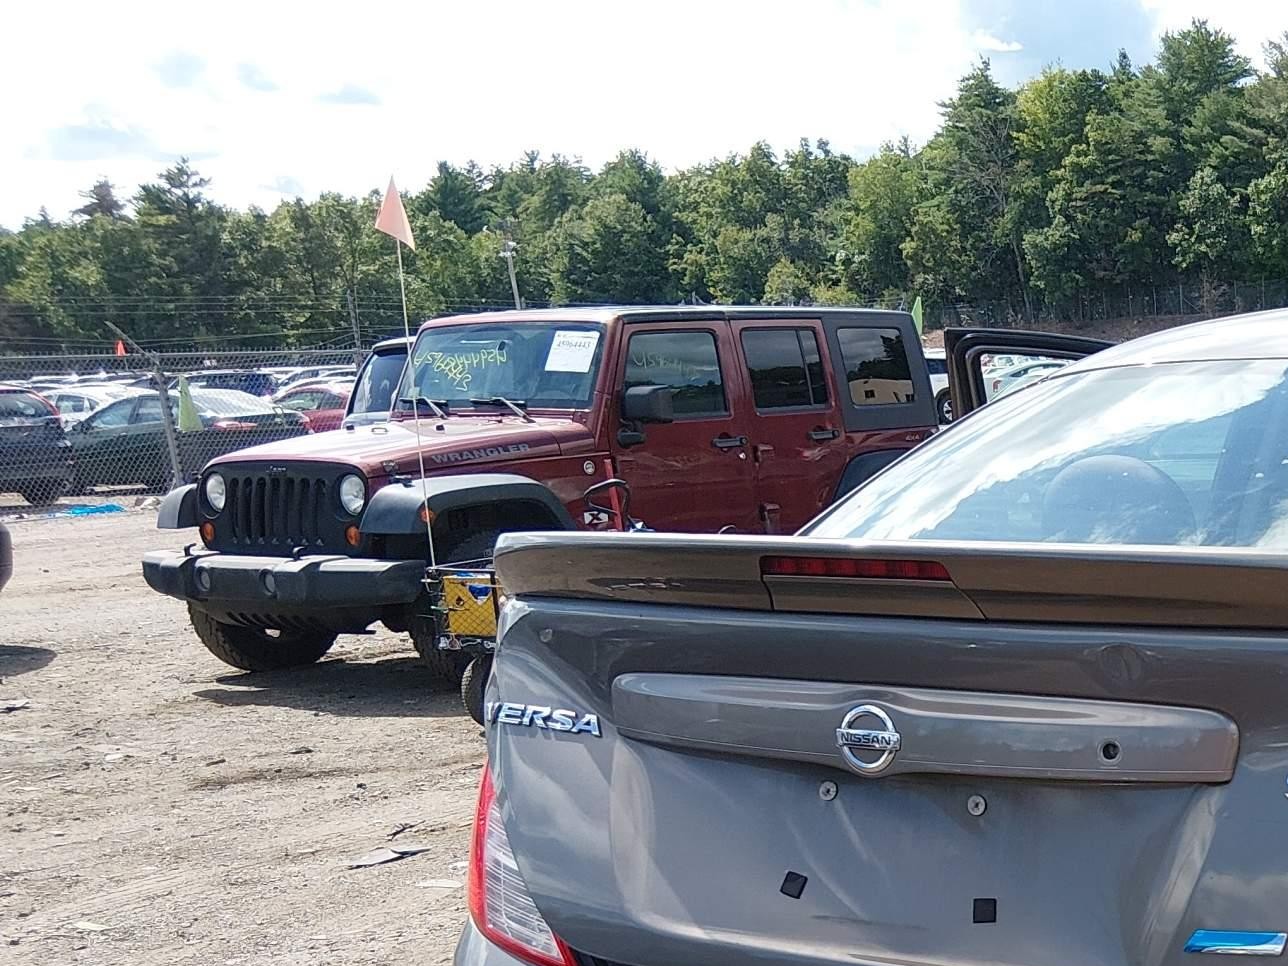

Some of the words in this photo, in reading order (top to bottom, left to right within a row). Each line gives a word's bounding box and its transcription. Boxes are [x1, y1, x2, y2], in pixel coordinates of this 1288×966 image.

[431, 442, 529, 463] WRANGLER
[487, 701, 601, 737] VERSA
[841, 733, 891, 746] NISSAN
